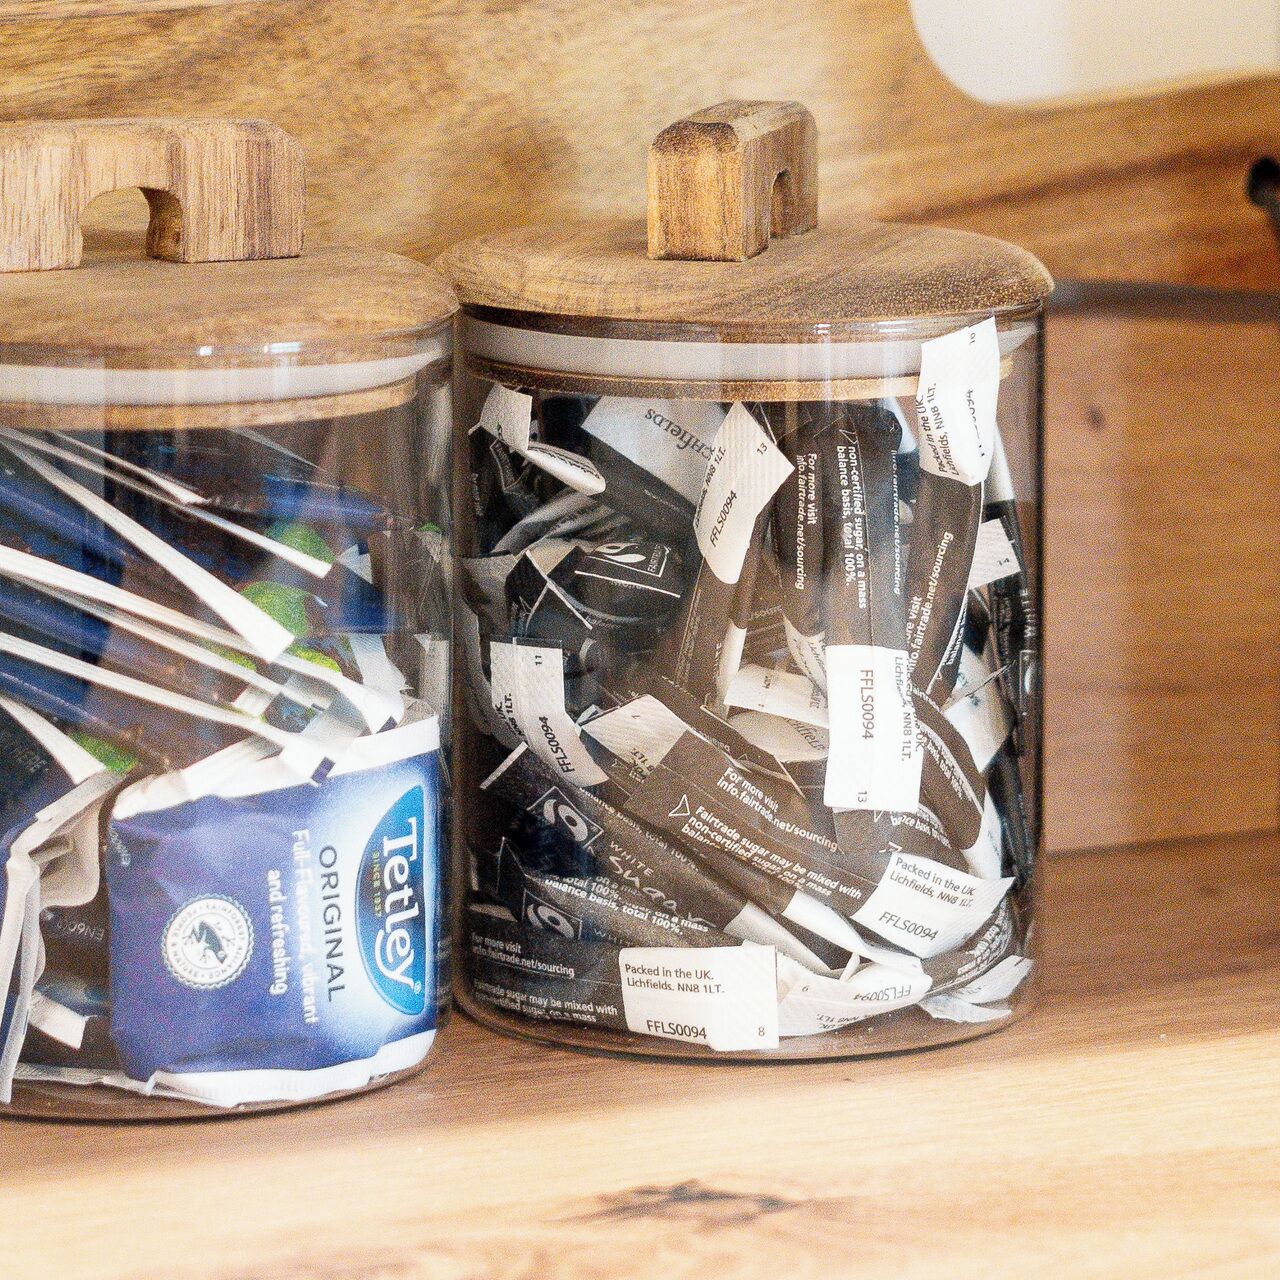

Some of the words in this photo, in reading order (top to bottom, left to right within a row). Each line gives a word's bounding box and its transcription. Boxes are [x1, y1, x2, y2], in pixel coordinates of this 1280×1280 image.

[920, 416, 932, 432] the
[930, 405, 945, 430] NN8
[756, 442, 768, 456] 13
[808, 453, 817, 470] For
[837, 445, 848, 487] balance
[848, 446, 864, 516] non-certified
[807, 472, 816, 501] more
[709, 489, 738, 547] FFLS0094
[807, 502, 817, 525] visit
[841, 489, 851, 519] basis,
[844, 553, 856, 587] 100%.
[856, 554, 864, 568] on
[858, 580, 868, 609] mass
[910, 595, 922, 621] visit
[859, 669, 875, 740] FFLS0094
[902, 712, 912, 736] NN8
[538, 716, 576, 774] FFLS0094
[901, 739, 912, 763] 1LT.
[723, 767, 740, 783] For
[742, 780, 764, 800] more
[764, 795, 780, 812] visit
[857, 790, 868, 803] 13
[716, 778, 839, 852] info.fairtrade.net/sourcing
[610, 841, 654, 877] WHITE
[688, 816, 753, 859] non-certified
[783, 871, 797, 882] on
[806, 881, 832, 898] mass
[695, 805, 740, 841] Fairtrade
[740, 836, 770, 858] sugar
[769, 853, 793, 871] may
[793, 860, 807, 876] be
[806, 869, 839, 890] mixed
[838, 881, 863, 901] with
[372, 850, 383, 889] SINCE
[895, 856, 931, 881] Packed
[932, 875, 943, 887] in
[944, 878, 962, 893] the
[267, 869, 287, 904] and
[890, 870, 935, 899] Lichfields,
[936, 890, 959, 905] NN8
[375, 817, 420, 990] Tetley
[589, 891, 620, 912] basis,
[621, 904, 649, 921] total
[652, 915, 684, 937] 100%.
[319, 845, 346, 1003] ORIGINAL
[680, 919, 709, 933] mass
[878, 910, 939, 941] FFLS0094
[269, 904, 291, 996] refreshing
[505, 943, 522, 954] visit
[625, 963, 660, 978] Packed
[661, 966, 672, 978] in
[673, 967, 692, 980] the
[694, 969, 714, 981] UK.
[677, 980, 700, 993] NN8
[703, 982, 725, 994] 1LT.
[301, 962, 320, 1024] vibrant
[506, 989, 528, 1002] sugar
[529, 995, 550, 1008] may
[551, 998, 562, 1008] be
[564, 1001, 593, 1013] mixed
[595, 1004, 618, 1016] with
[572, 1013, 597, 1023] mass
[646, 1019, 707, 1039] FFLS0094
[757, 1026, 766, 1037] 8
